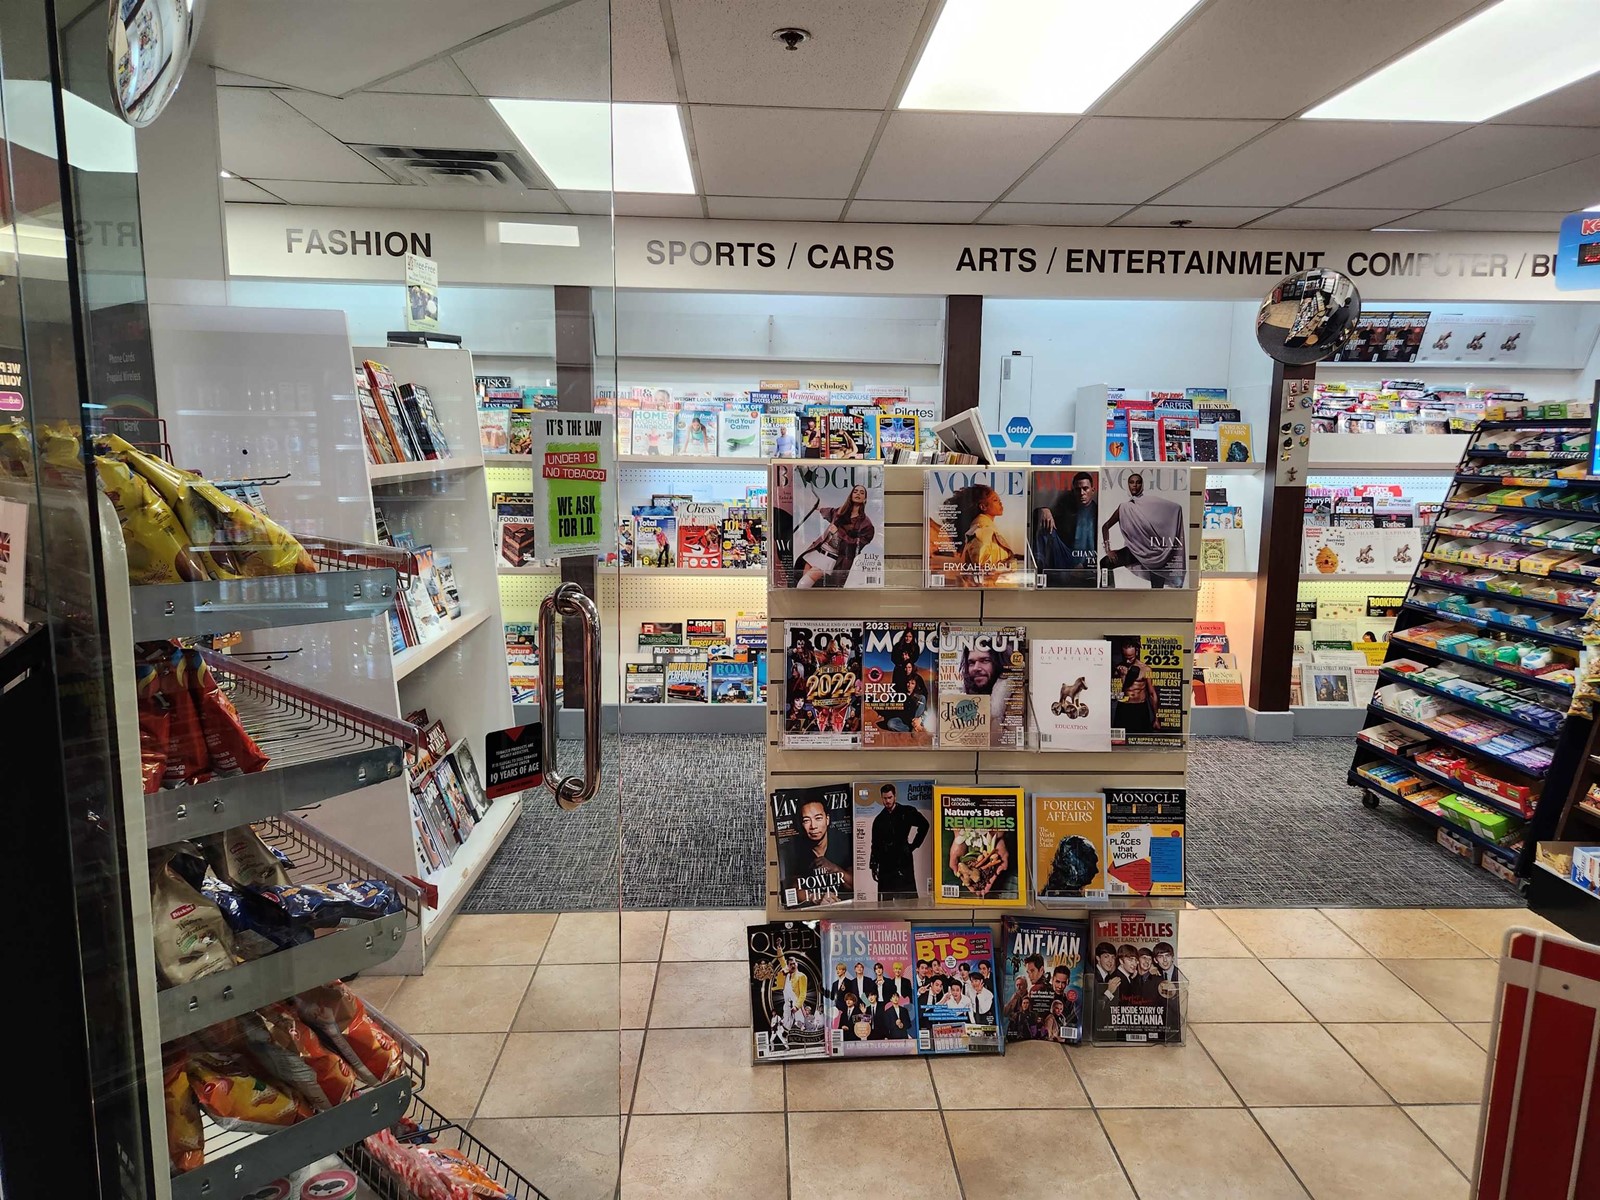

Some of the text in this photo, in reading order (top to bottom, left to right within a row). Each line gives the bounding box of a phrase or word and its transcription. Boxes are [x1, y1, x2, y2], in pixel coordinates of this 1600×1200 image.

[286, 228, 432, 258] FASHION
[646, 239, 895, 271] SPORTS / CARS
[955, 247, 1325, 276] ARTS / ENTERTAINMENT
[1347, 251, 1508, 278] COMPUTER
[1514, 252, 1527, 280] /
[808, 382, 848, 391] Psychology
[600, 390, 612, 399] GUT
[789, 392, 827, 401] Menopause
[635, 411, 668, 419] HOME
[894, 407, 934, 418] Pilates
[546, 419, 602, 436] IT'S THE LAW
[830, 422, 863, 431] MUSCLE
[897, 435, 915, 444] Body
[547, 453, 596, 465] UNDER 19
[545, 466, 605, 481] NO TOBACCO
[794, 464, 883, 489] VOGUE
[1104, 468, 1188, 492] VOGUE
[557, 496, 596, 516] WE ASK
[686, 503, 716, 514] Chess
[558, 517, 596, 537] FOR I.D.
[1150, 536, 1183, 547] IMAN
[642, 557, 649, 565] 6
[864, 553, 880, 561] Lily
[943, 562, 1012, 572] ERYKAH BADU
[516, 625, 531, 633] DOT
[941, 634, 1024, 653] UNCUT
[1040, 646, 1104, 656] LAPHAM'S
[1143, 655, 1180, 666] 2023
[716, 664, 750, 674] ROVA
[1160, 671, 1181, 679] MUSCLE
[806, 672, 857, 701] 2022
[865, 683, 896, 693] PINK
[1151, 679, 1181, 687] MADE EASY
[864, 692, 908, 703] FLOYD
[1054, 723, 1089, 731] EDUCATION
[490, 762, 540, 784] 19 YEARS OF AGE
[1112, 793, 1180, 804] MONOCLE
[1043, 800, 1095, 811] FOREIGN
[944, 808, 1004, 816] Nature's Best
[1046, 811, 1093, 822] AFFAIRS
[944, 816, 1015, 828] REMEDIES
[1109, 838, 1142, 846] PLACES
[797, 872, 846, 890] POWER
[805, 887, 841, 901] FIFTY
[1096, 922, 1174, 938] THE BEATLES
[831, 929, 908, 957] BTS ULTIMATE
[867, 942, 908, 955] FANBOOK
[1013, 932, 1081, 956] ANT-MAN
[915, 937, 970, 962] BTS
[1110, 1006, 1164, 1014] THE INSIDE STORY OF
[1111, 1014, 1164, 1025] BEATLEMANIA
